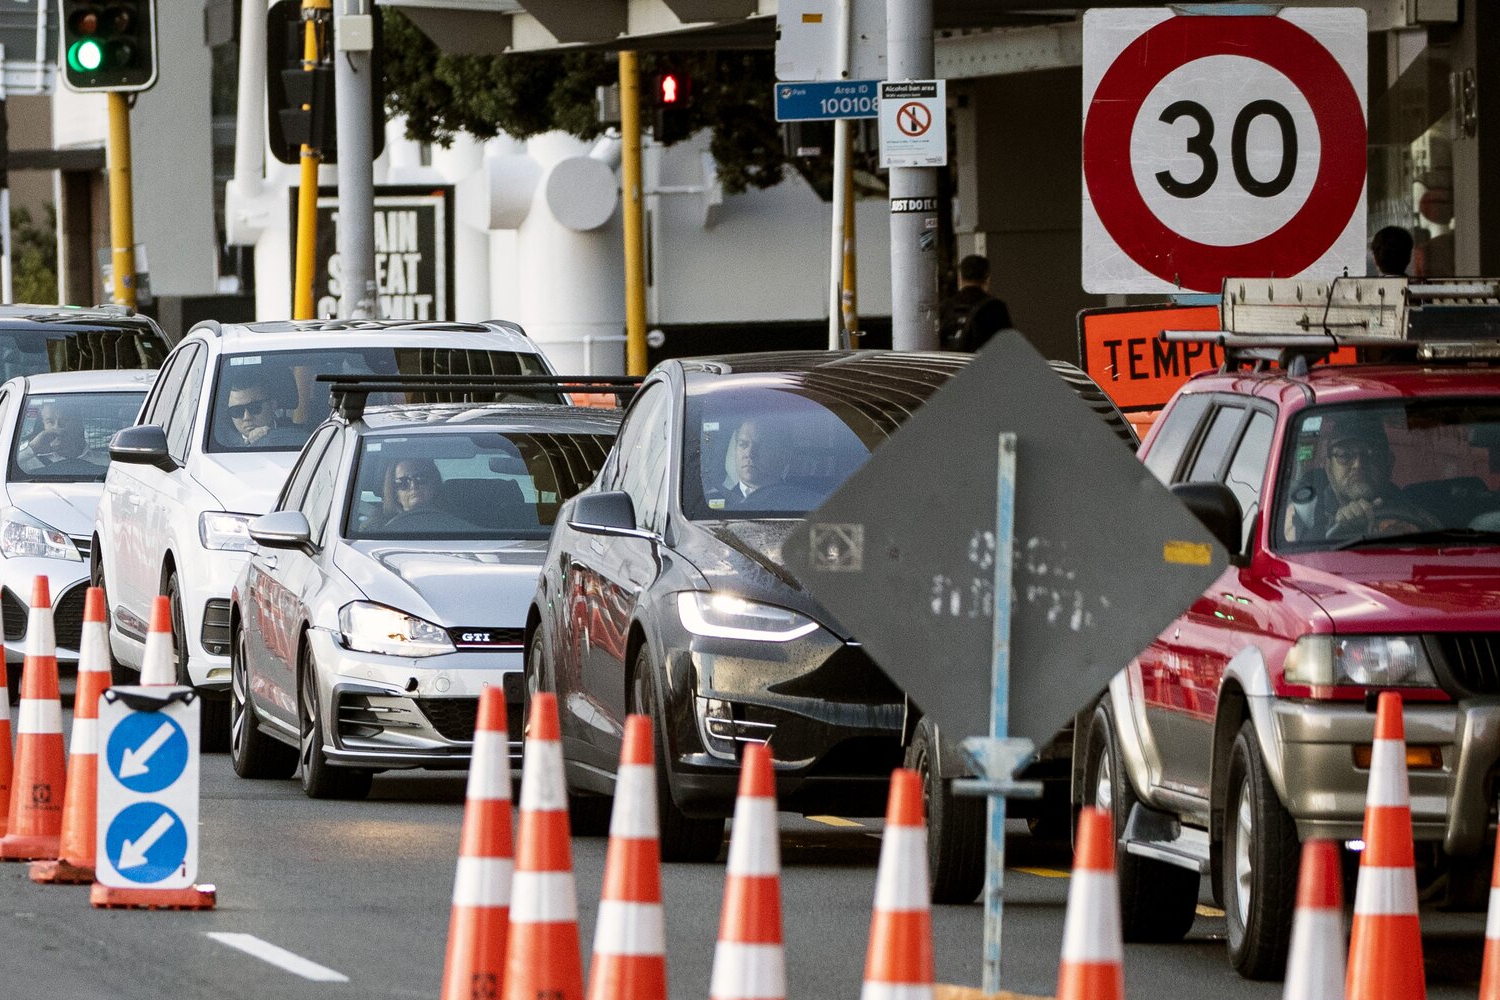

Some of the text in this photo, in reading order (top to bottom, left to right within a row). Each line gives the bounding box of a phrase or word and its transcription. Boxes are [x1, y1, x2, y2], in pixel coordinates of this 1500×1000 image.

[834, 85, 868, 94] Area ID
[1155, 99, 1298, 199] 30
[909, 200, 923, 210] DO
[331, 211, 418, 252] TAIN
[327, 253, 422, 295] SEAT
[462, 633, 490, 641] GTI
